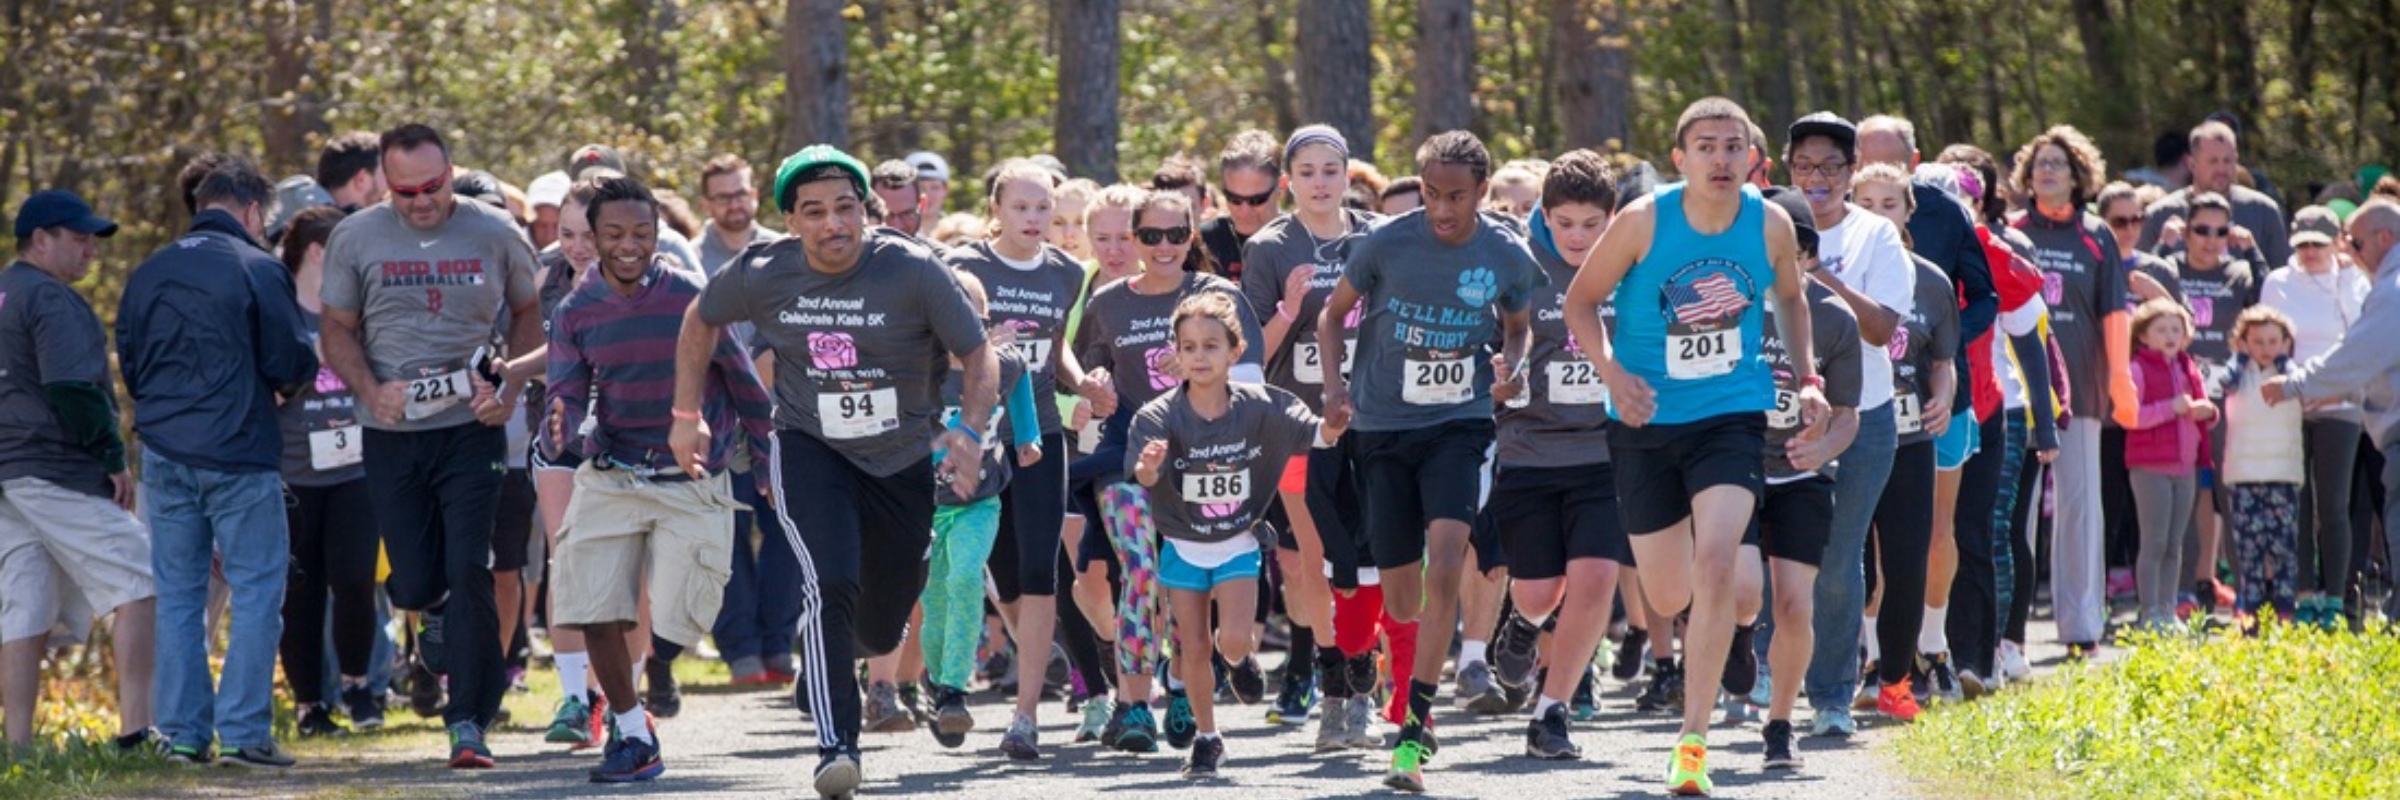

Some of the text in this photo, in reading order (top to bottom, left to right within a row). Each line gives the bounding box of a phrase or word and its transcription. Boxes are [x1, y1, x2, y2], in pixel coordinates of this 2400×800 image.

[383, 258, 482, 276] RED SOX
[382, 274, 464, 287] BASEBALL
[798, 296, 864, 310] 2nd Annual
[997, 286, 1052, 302] 2nd Annual
[988, 300, 1028, 314] elebrate
[1029, 303, 1052, 317] Kate
[779, 311, 885, 326] Celebrate Kate 5K
[1130, 318, 1152, 330] 2nd
[1114, 331, 1165, 347] Celebrate
[1394, 322, 1468, 348] HISTORY
[1679, 333, 1726, 361] 201
[1416, 362, 1465, 387] 200
[412, 376, 457, 402] 221
[840, 393, 874, 419] 94
[335, 431, 347, 450] 3
[1189, 446, 1211, 459] 2nd
[1211, 438, 1247, 457] Annual
[1197, 474, 1242, 498] 186
